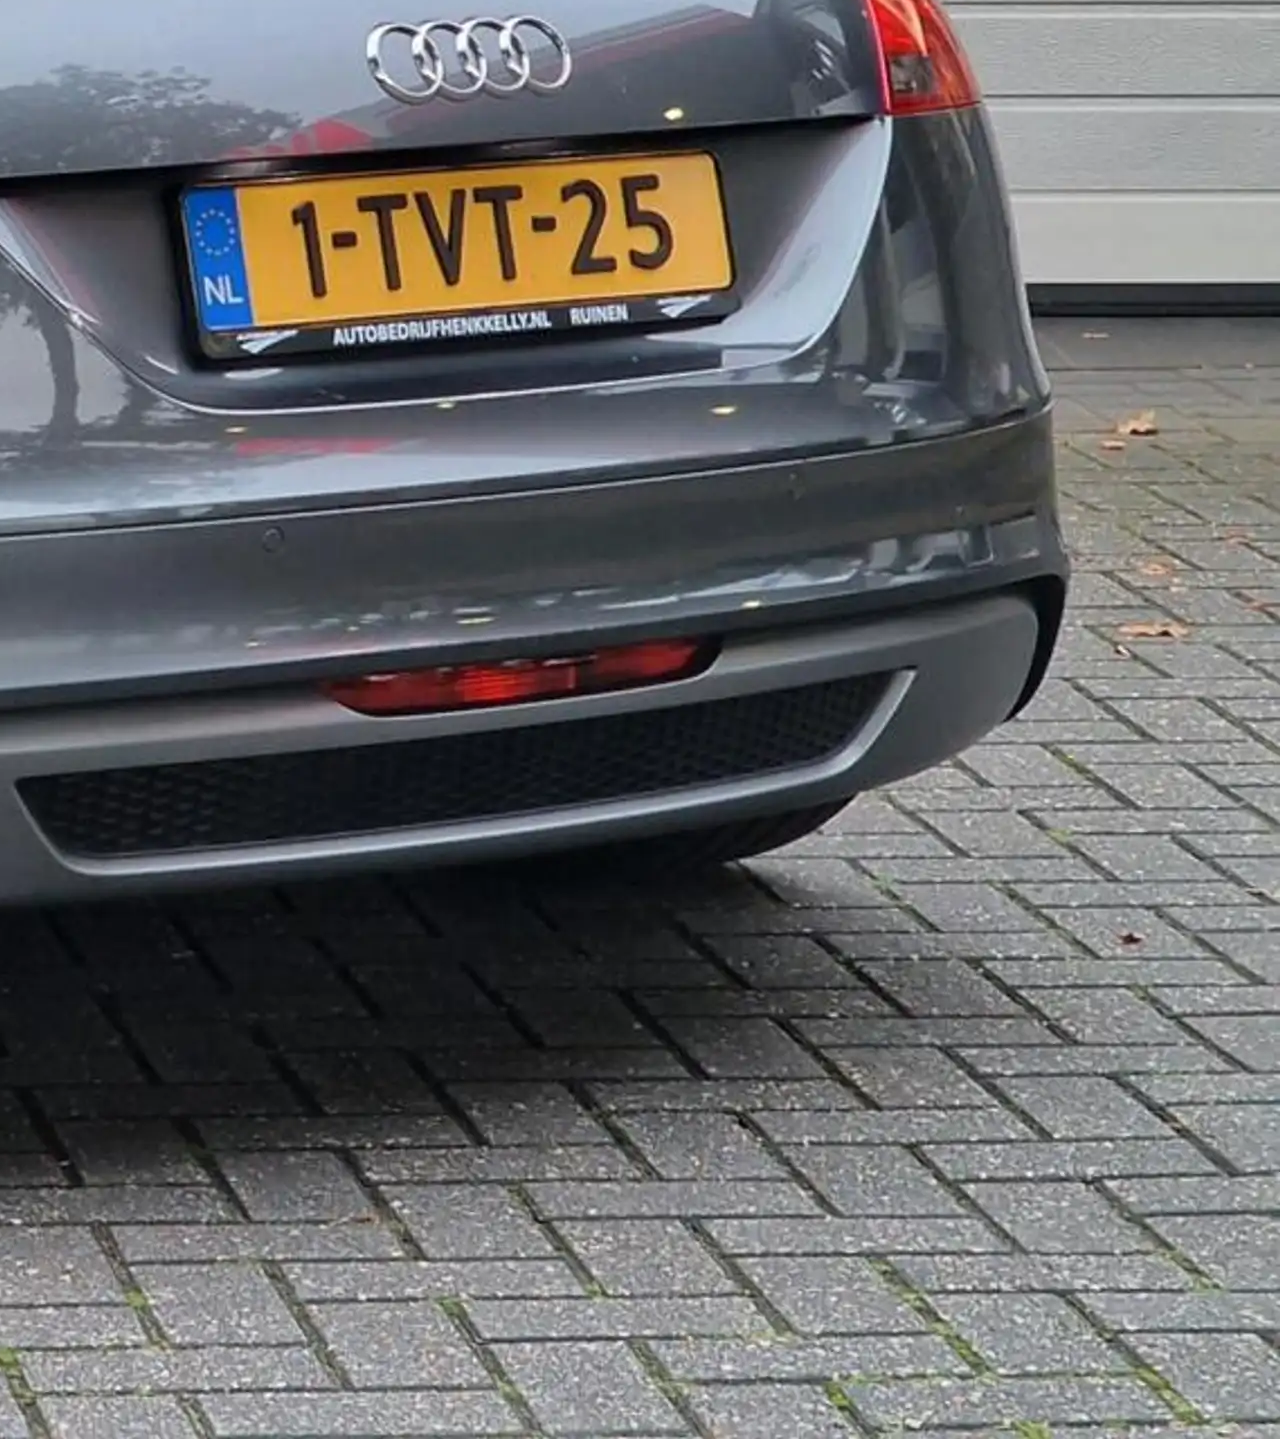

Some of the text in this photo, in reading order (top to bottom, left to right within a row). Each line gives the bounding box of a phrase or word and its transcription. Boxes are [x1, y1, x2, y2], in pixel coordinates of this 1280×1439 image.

[290, 173, 675, 298] 1-TVT-25
[203, 276, 244, 307] NL
[332, 302, 629, 346] AUTOBEDRIJFHENKKELLY.NL RUINEN
